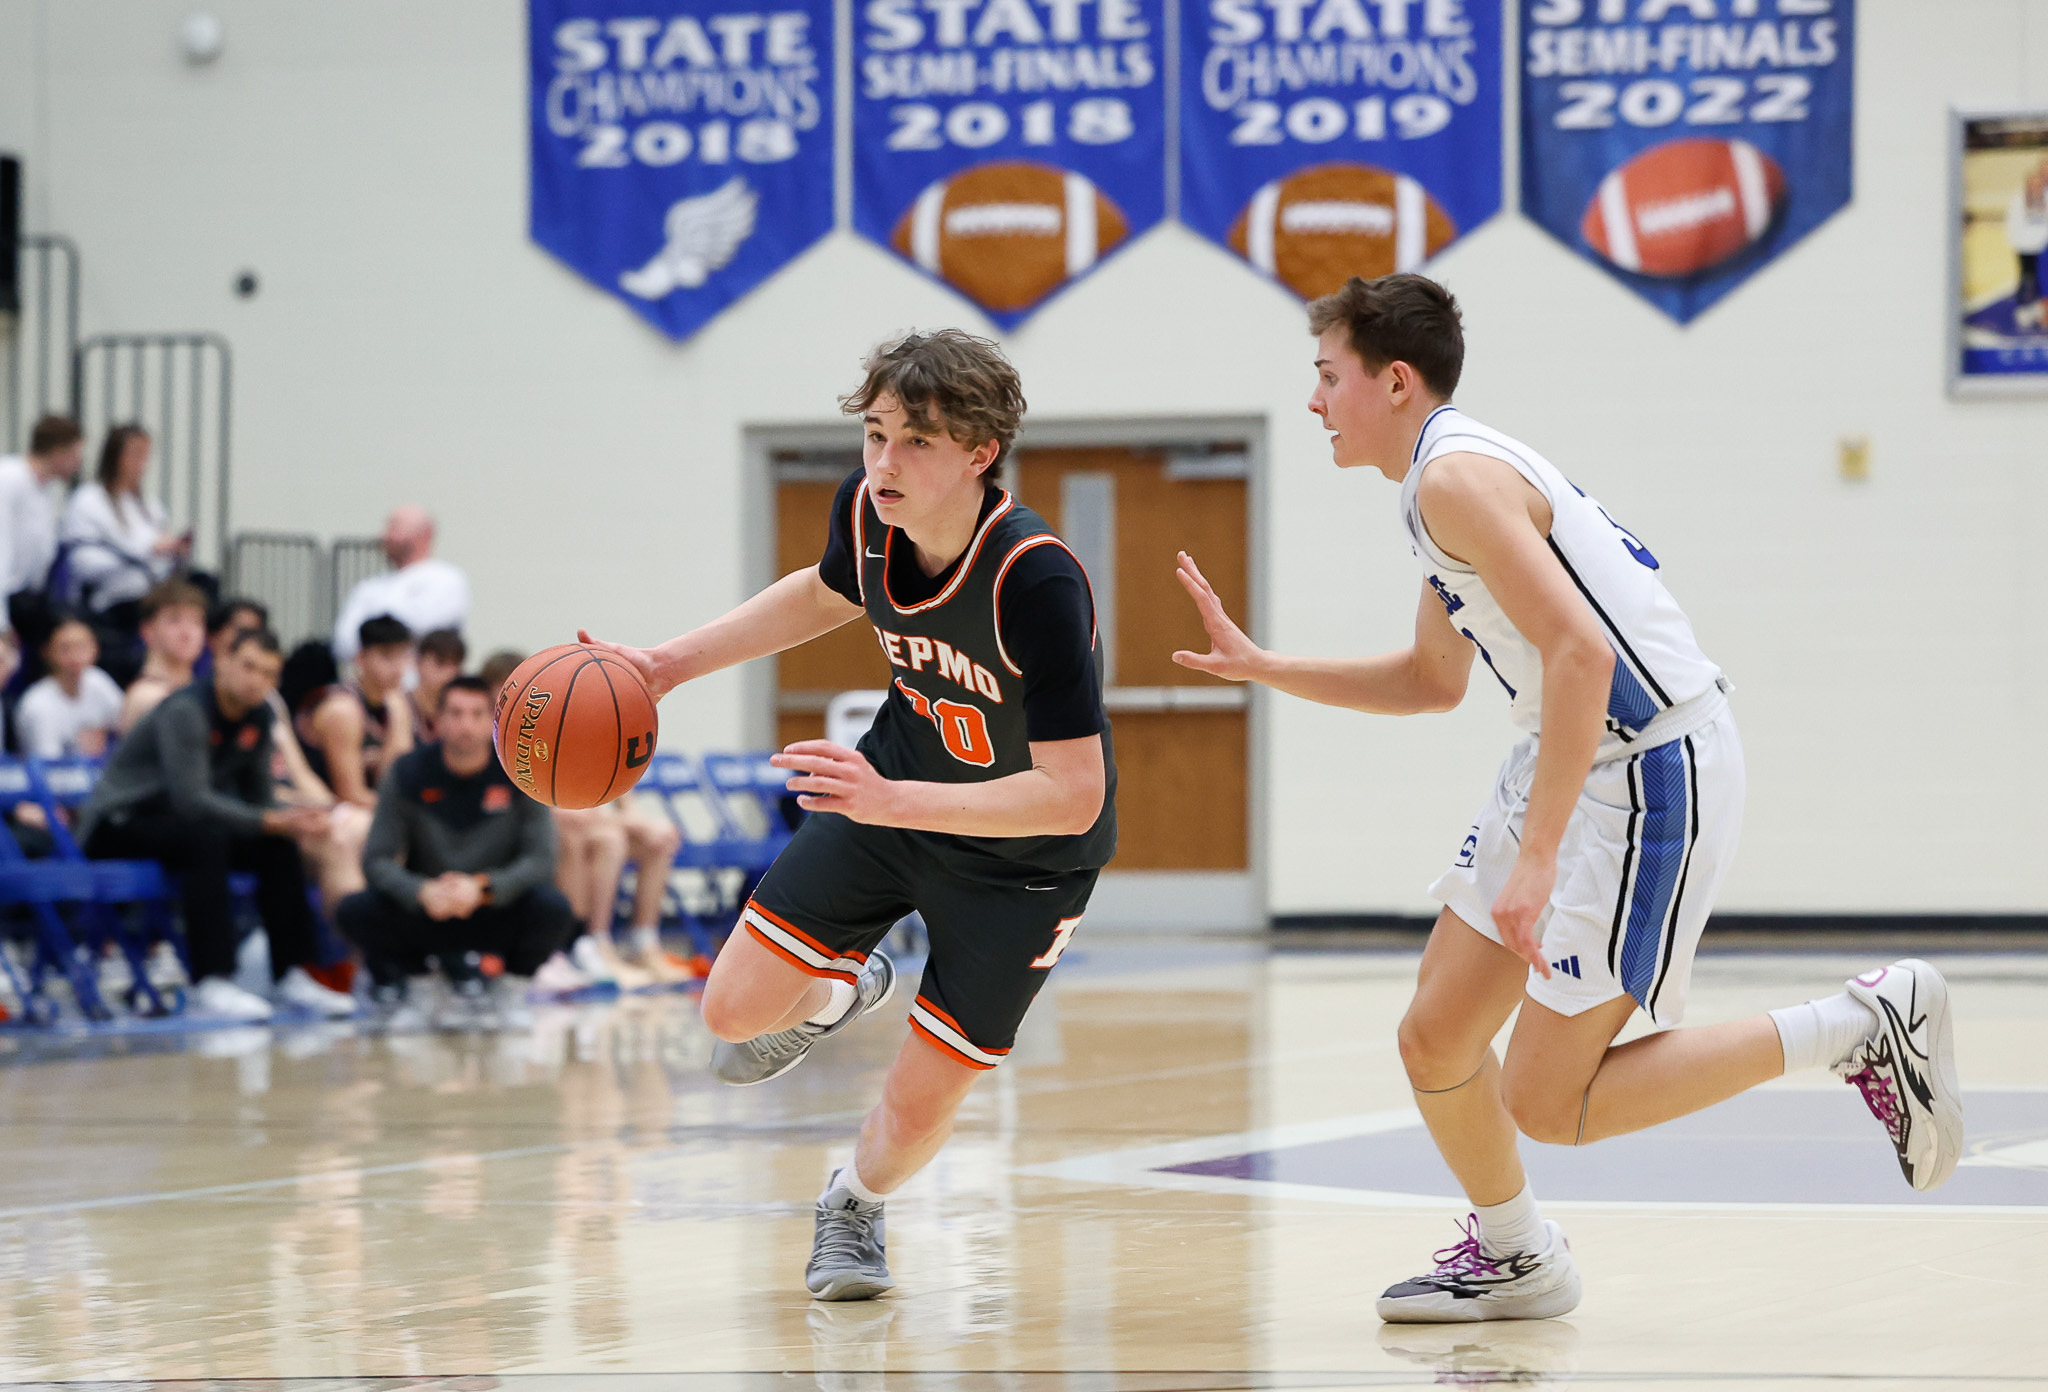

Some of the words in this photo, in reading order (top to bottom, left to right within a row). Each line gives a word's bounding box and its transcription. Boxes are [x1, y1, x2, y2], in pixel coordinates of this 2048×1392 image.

[554, 13, 813, 73] STATE
[863, 0, 1151, 50] STATE
[1208, 0, 1474, 46] STATE
[1528, 19, 1836, 77] SEMI-FINALS
[863, 43, 1154, 98] SEMI-FINALS
[1202, 37, 1478, 111] CHAMPIONS
[546, 65, 820, 137] CHAMPIONS
[887, 97, 1134, 151] 2018
[1226, 96, 1453, 146] 2019
[1552, 73, 1812, 130] 2022
[577, 119, 799, 168] 2018
